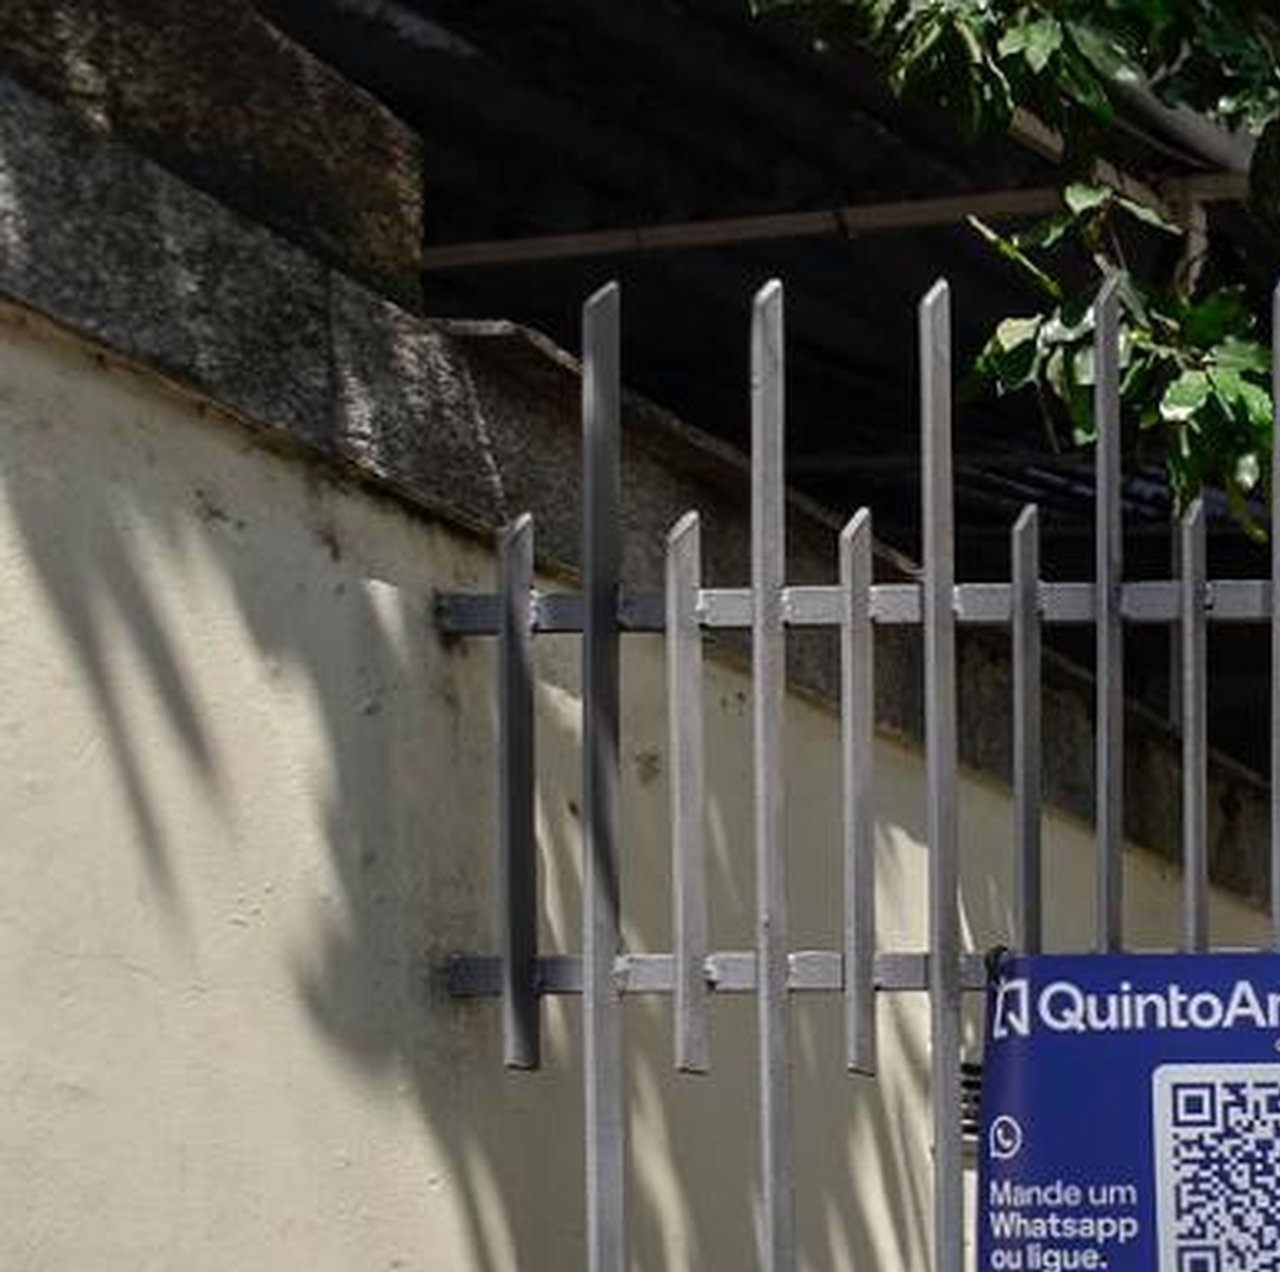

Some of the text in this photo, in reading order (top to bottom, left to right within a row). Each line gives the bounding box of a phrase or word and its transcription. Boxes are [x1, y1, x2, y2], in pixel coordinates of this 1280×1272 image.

[990, 1182, 1137, 1206] Mande um
[990, 1212, 1140, 1243] Whatsapp
[991, 1249, 1024, 1269] ou
